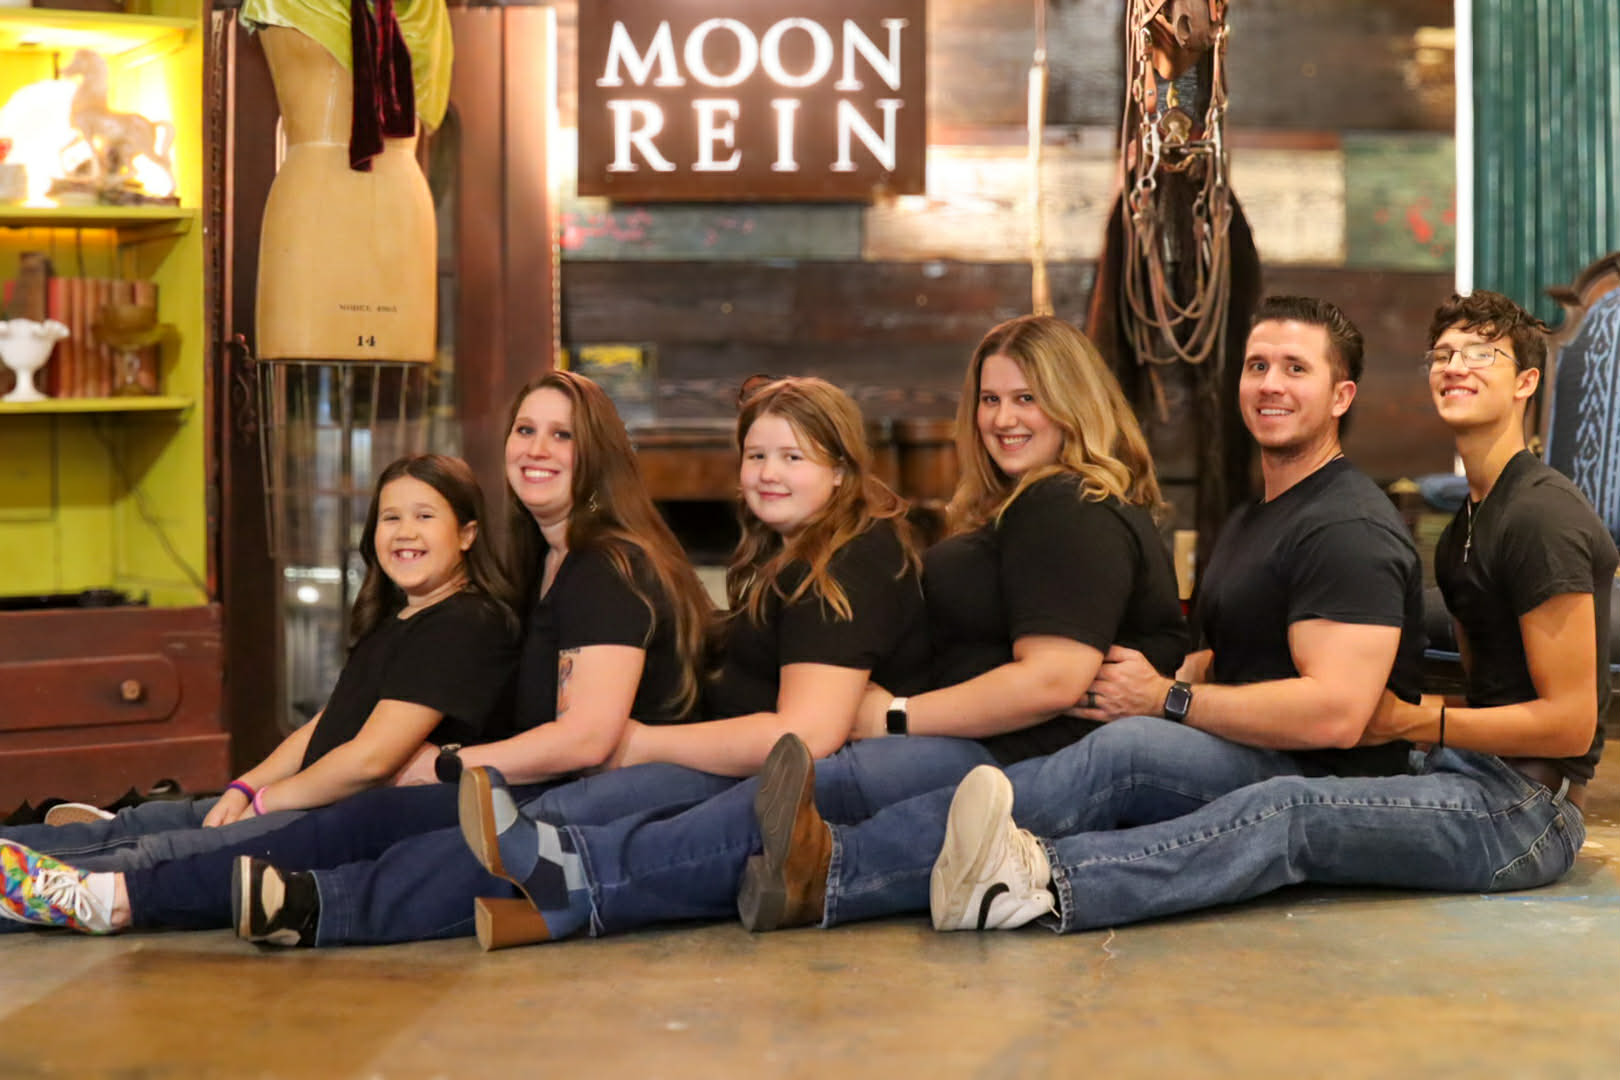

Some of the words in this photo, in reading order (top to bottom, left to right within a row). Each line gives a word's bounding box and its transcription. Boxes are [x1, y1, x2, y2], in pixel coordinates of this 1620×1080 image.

[596, 17, 908, 91] MOON
[606, 98, 904, 172] REIN
[357, 335, 376, 347] 14
